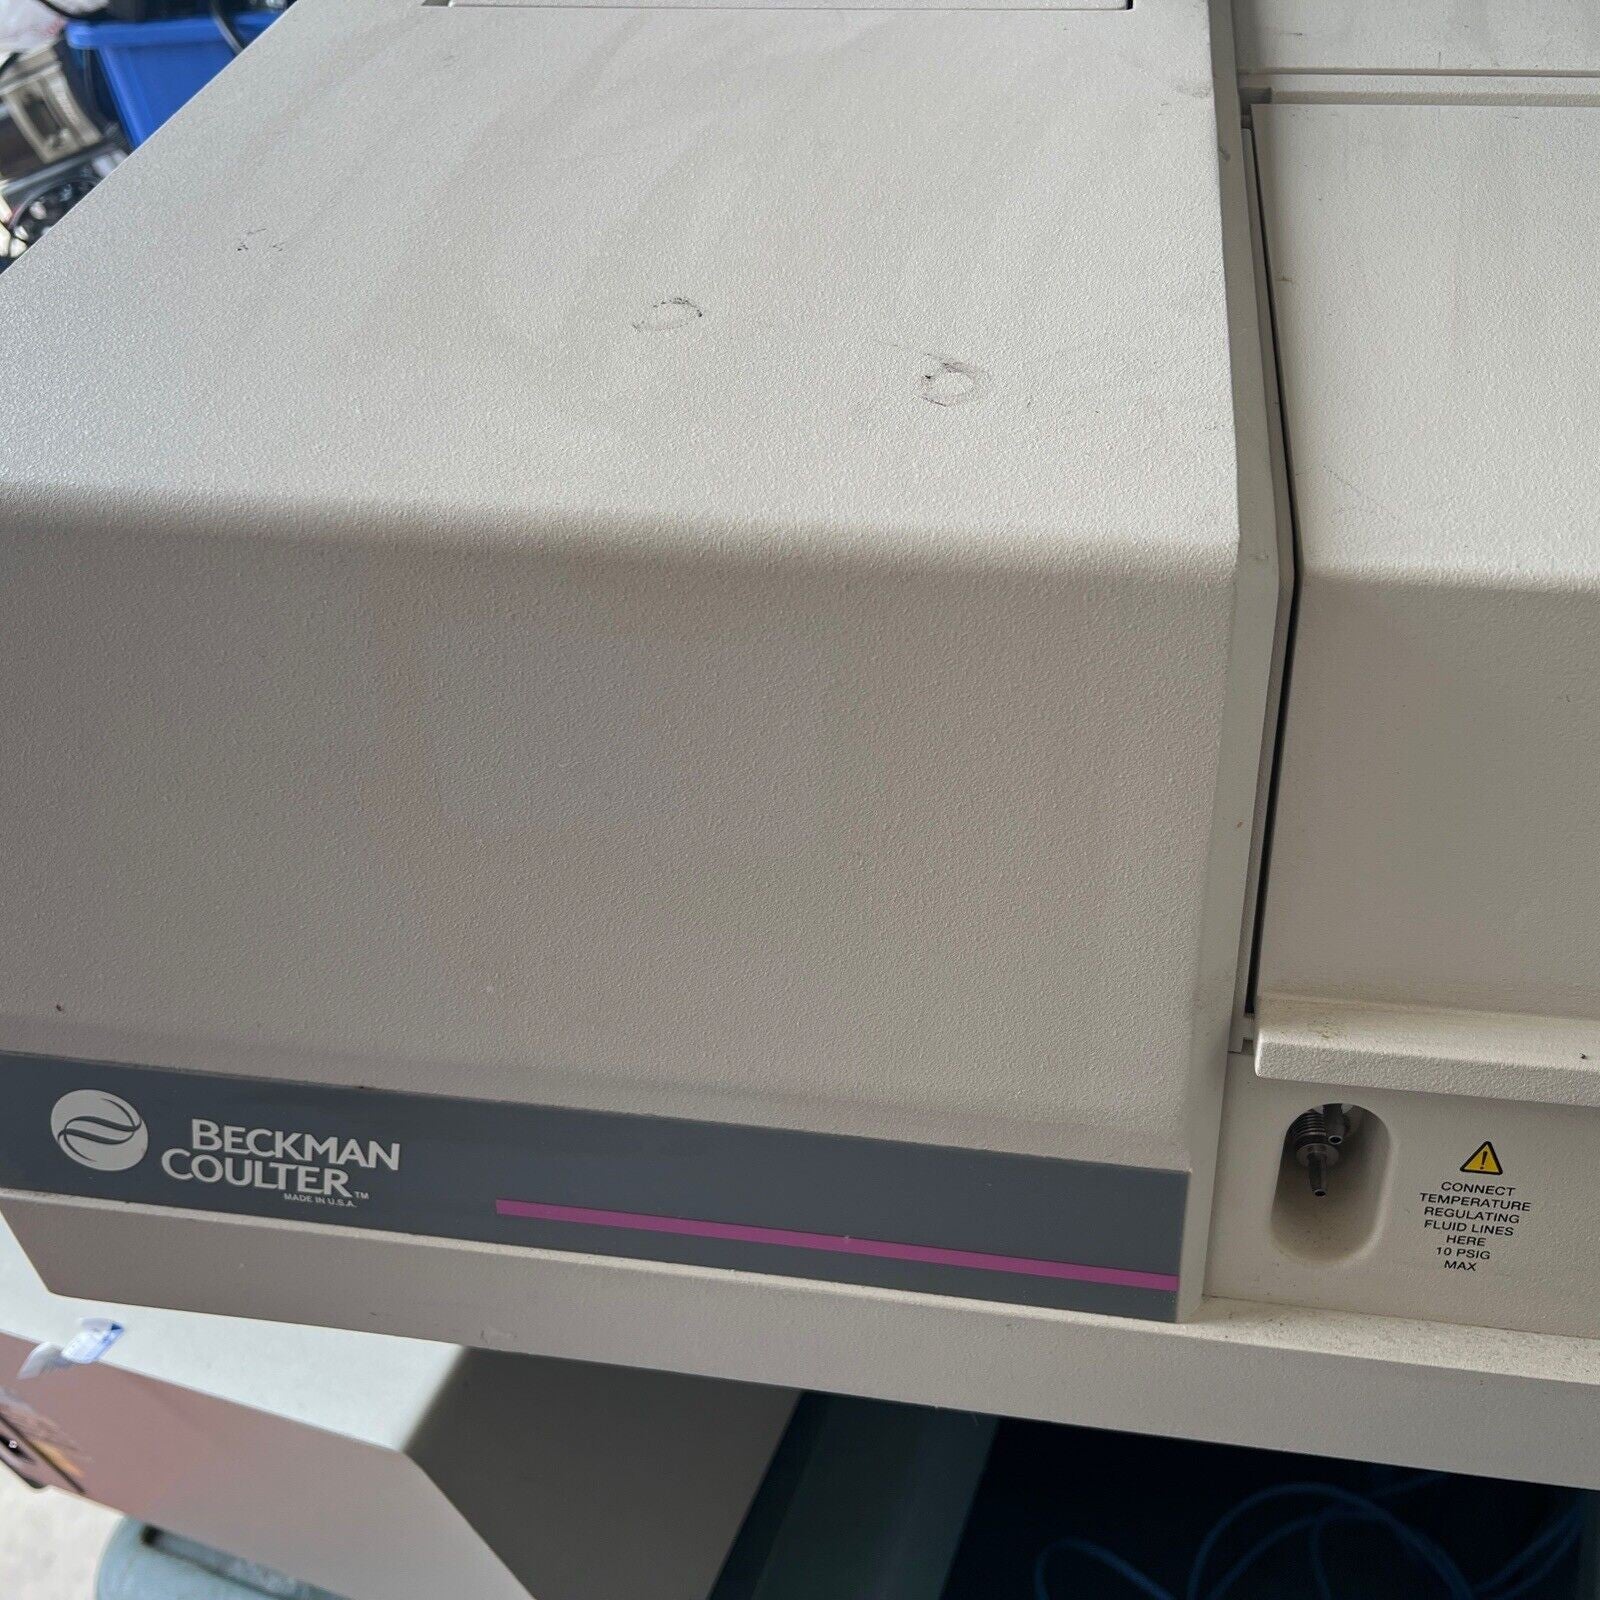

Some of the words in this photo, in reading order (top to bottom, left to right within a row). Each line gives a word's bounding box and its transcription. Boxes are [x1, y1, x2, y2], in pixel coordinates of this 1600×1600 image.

[192, 1118, 401, 1171] BECKMAN
[161, 1148, 352, 1198] COULTER
[1441, 1181, 1516, 1196] CONNECT
[283, 1193, 312, 1203] MADE
[315, 1196, 326, 1205] IN
[1419, 1192, 1532, 1211] TEMPERATURE
[1424, 1206, 1520, 1224] REGULATING
[1424, 1219, 1467, 1232] FLUID
[1471, 1223, 1514, 1236] LINES
[1446, 1235, 1487, 1247] HERE
[1436, 1247, 1452, 1256] 10
[1456, 1249, 1491, 1260] PSIG
[1444, 1260, 1477, 1272] MAX
